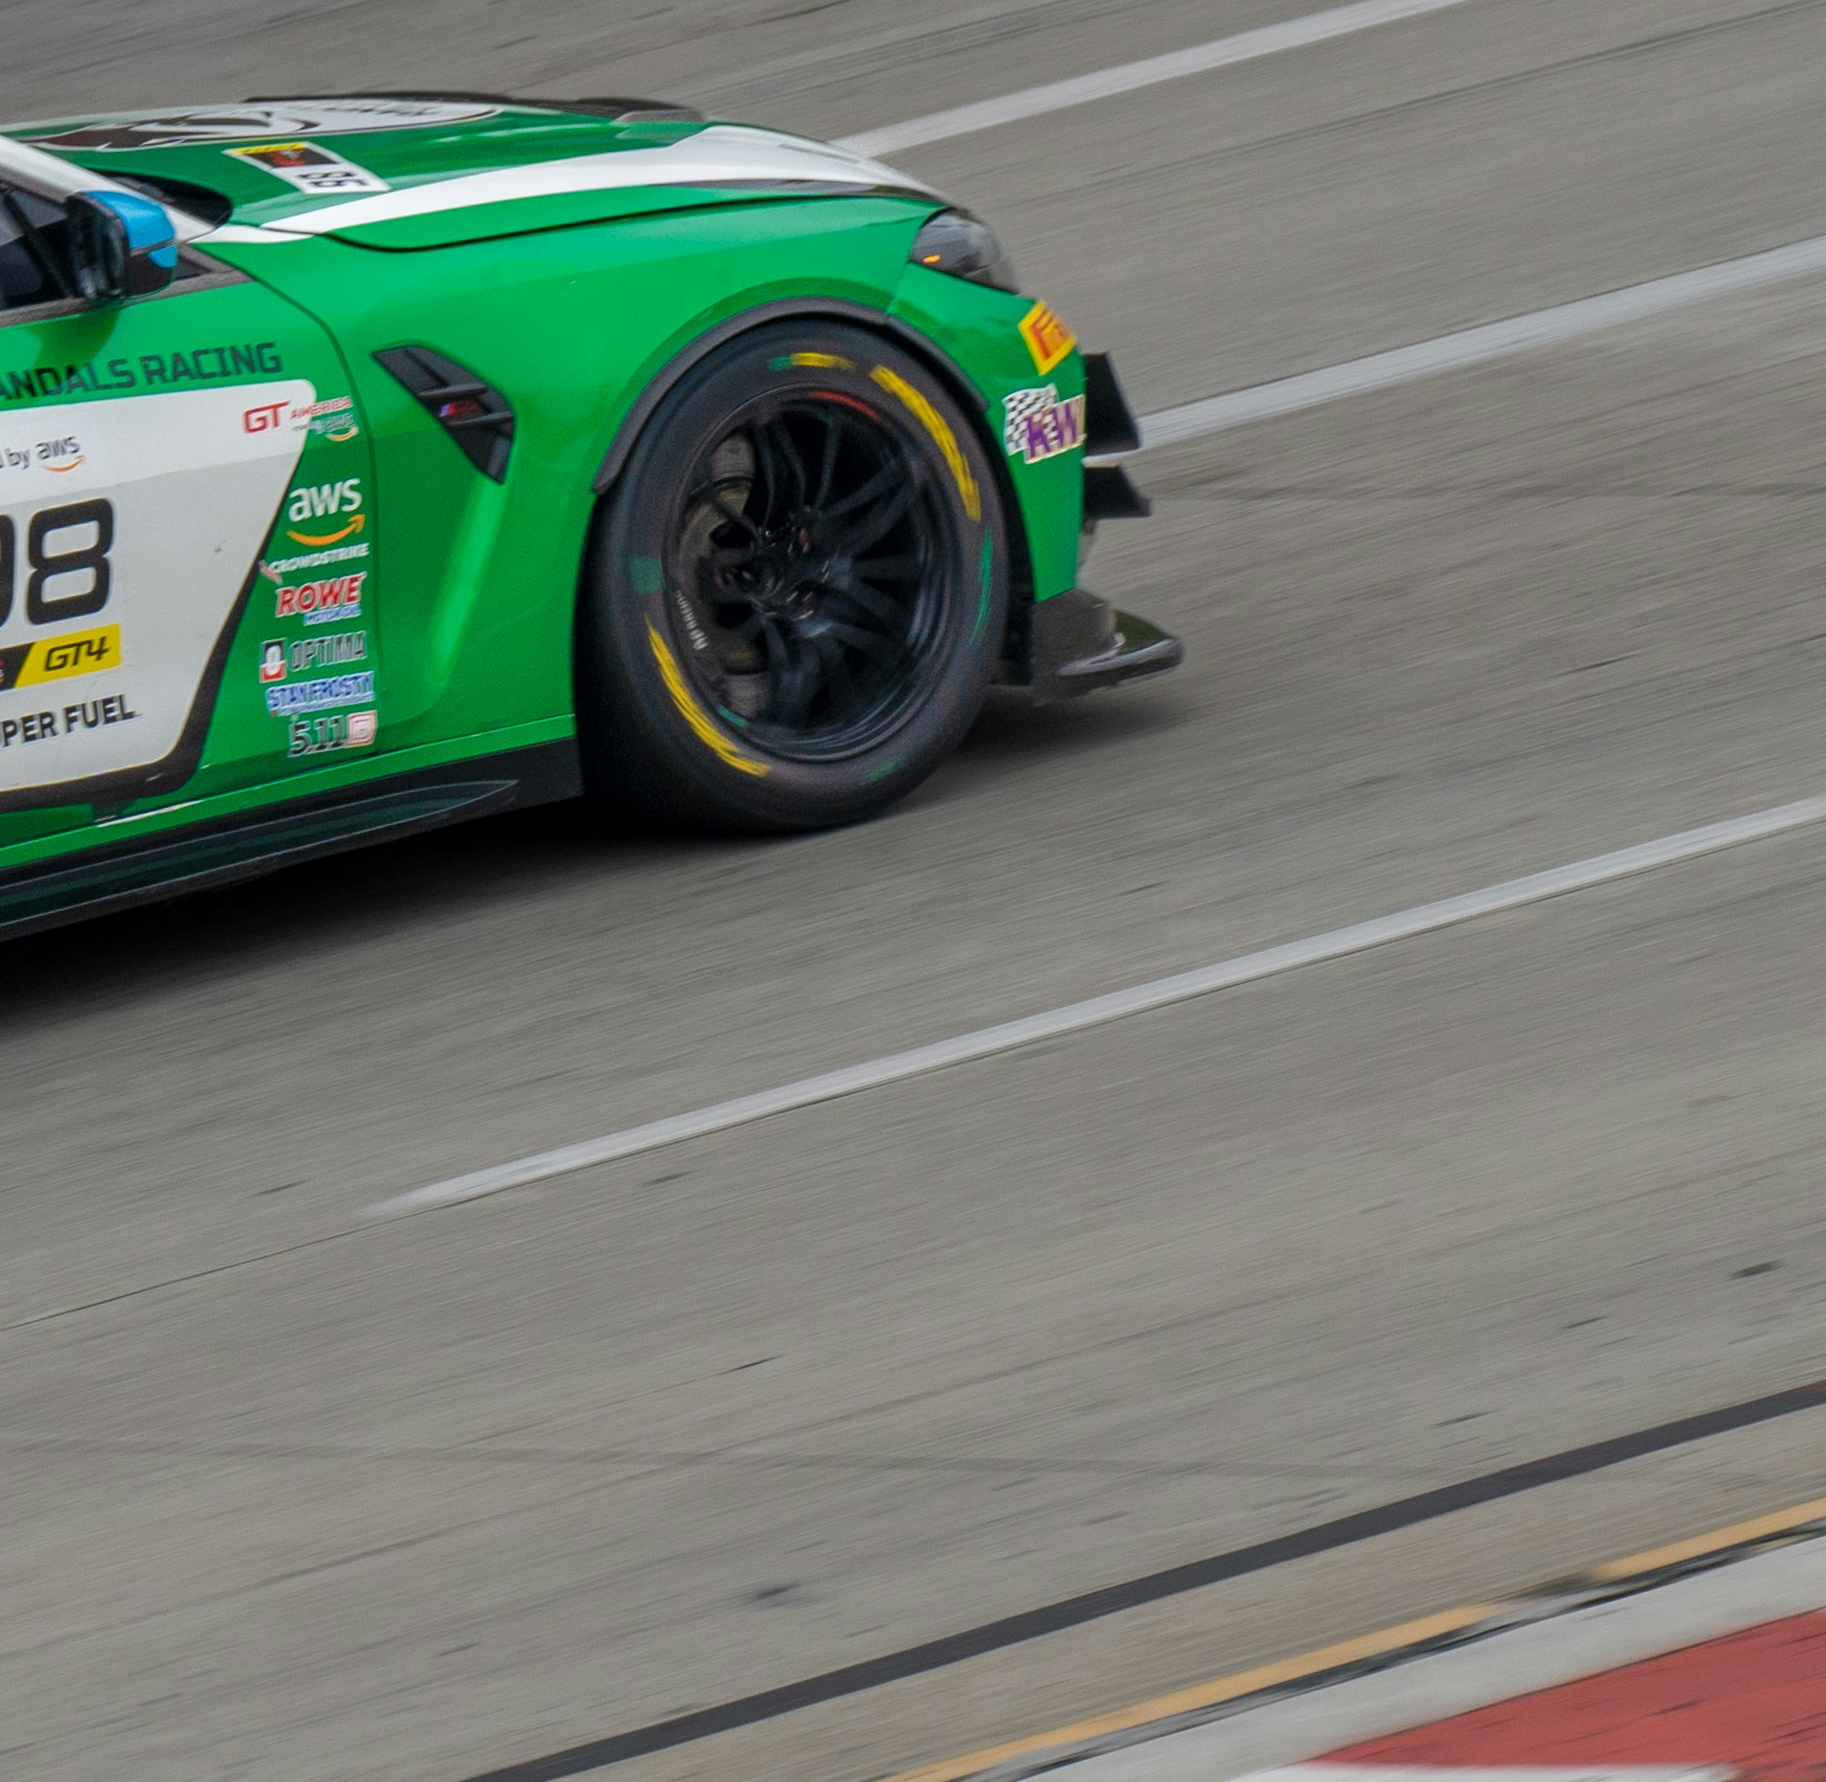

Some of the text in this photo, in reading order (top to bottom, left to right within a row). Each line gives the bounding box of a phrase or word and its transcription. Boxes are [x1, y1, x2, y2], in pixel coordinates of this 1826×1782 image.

[139, 341, 282, 385] RACING
[243, 400, 291, 434] GT
[4, 447, 31, 470] by
[35, 436, 81, 460] aws
[288, 478, 363, 522] aws
[275, 571, 368, 618] ROWE
[44, 636, 110, 672] GT4
[289, 630, 368, 672] OPTIMA
[62, 693, 136, 734] FUEL
